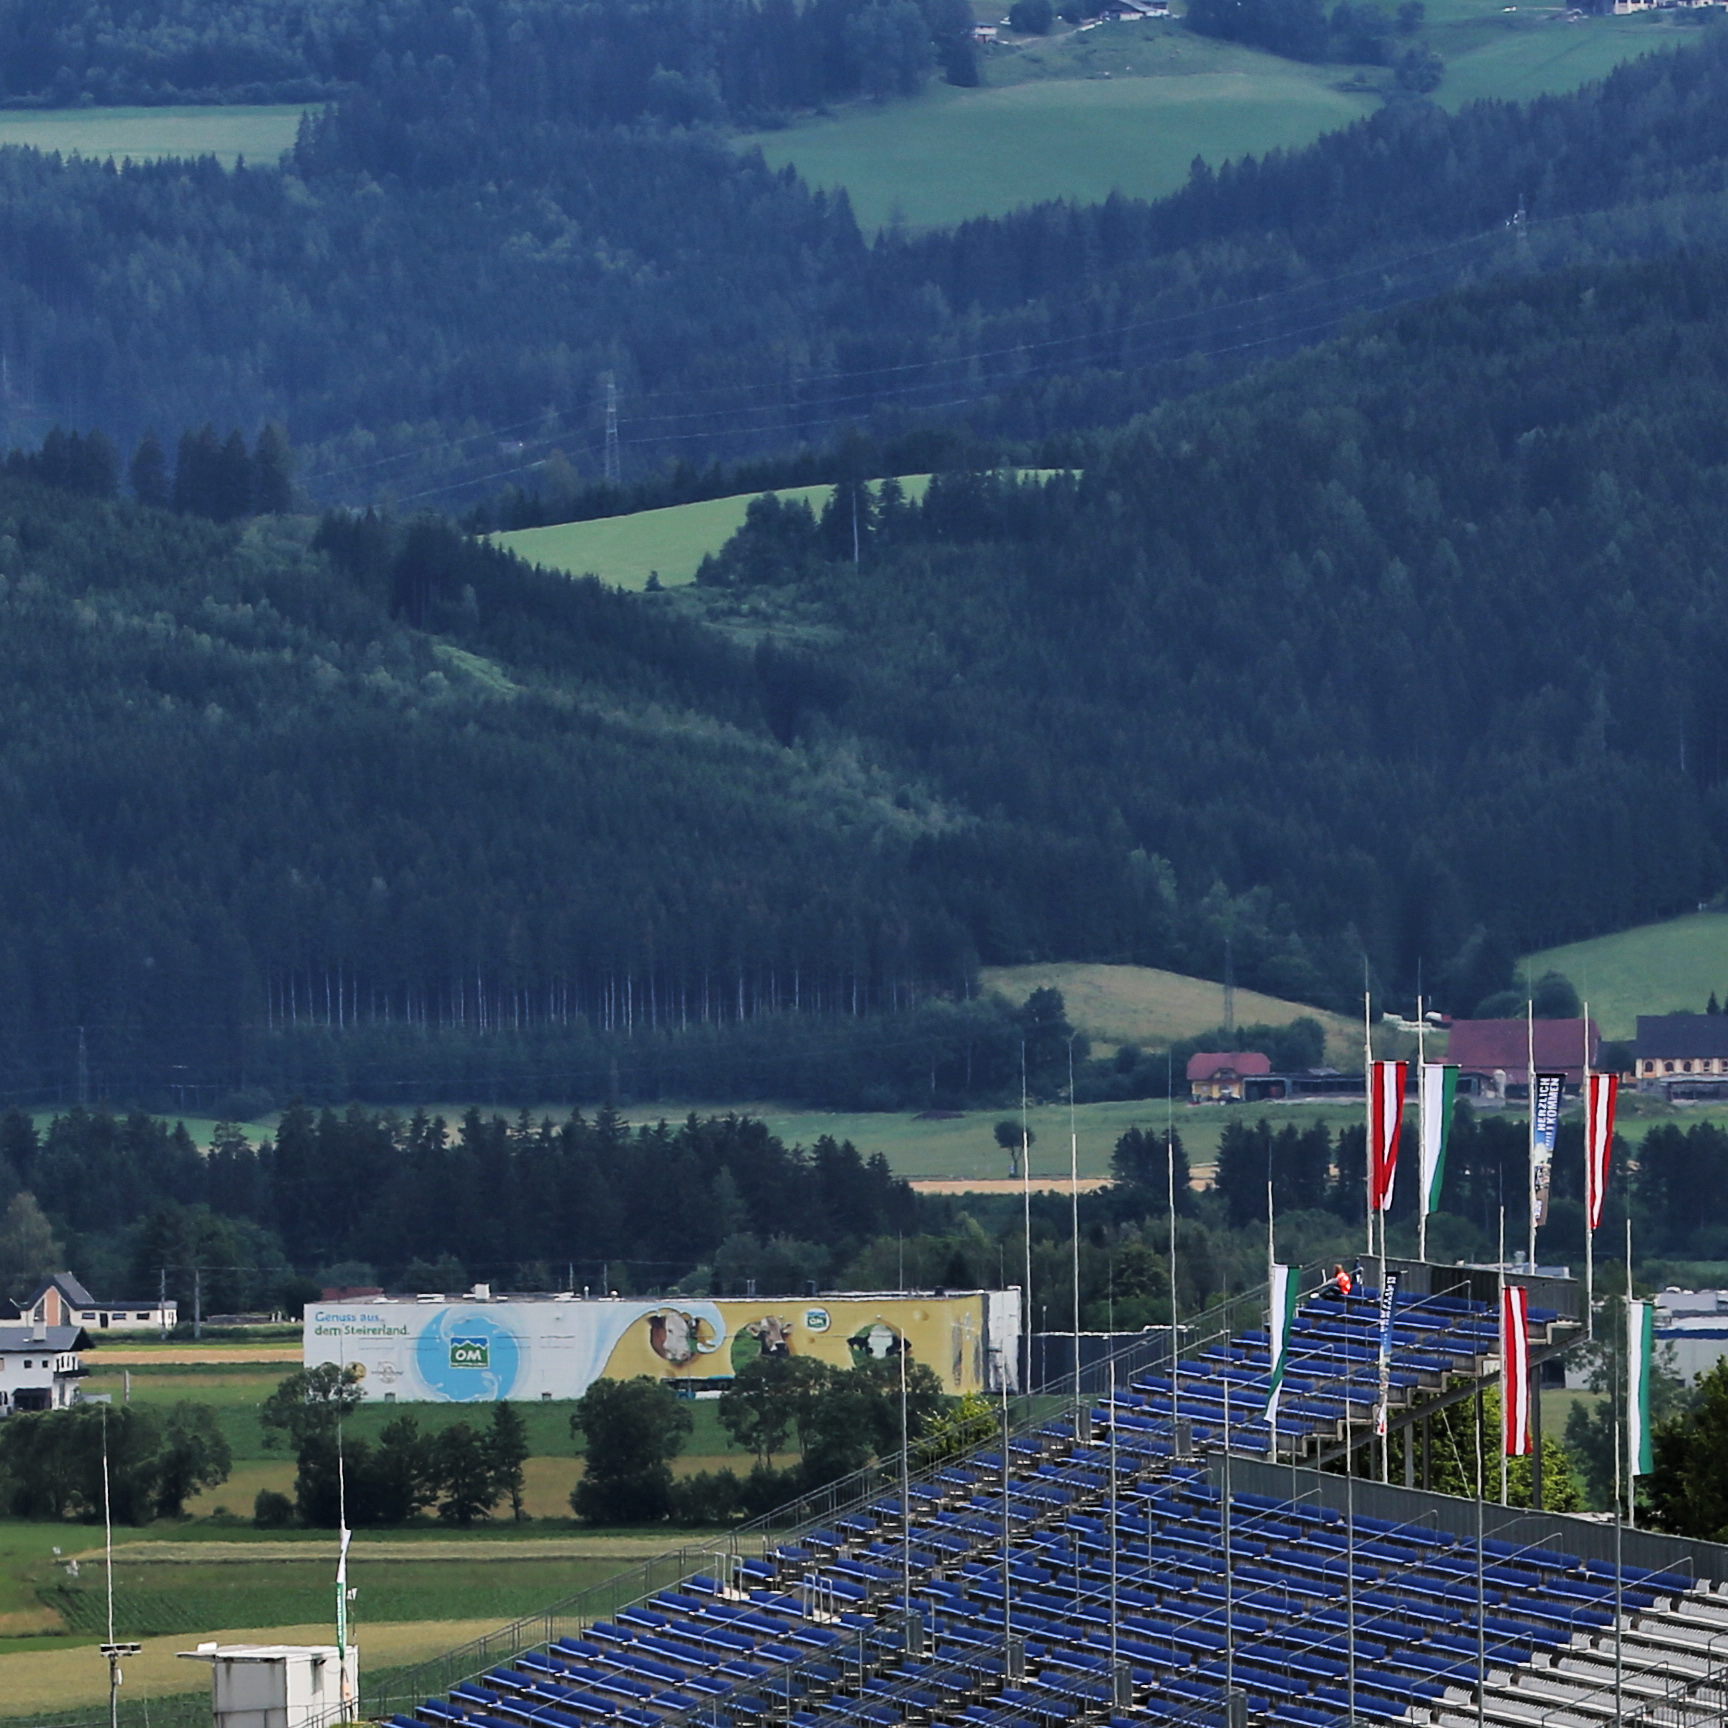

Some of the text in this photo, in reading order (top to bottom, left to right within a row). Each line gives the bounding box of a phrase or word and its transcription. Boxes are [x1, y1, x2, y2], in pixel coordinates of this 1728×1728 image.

[1537, 1077, 1551, 1131] HERZLICH
[315, 1311, 356, 1322] Genuss
[314, 1324, 410, 1336] dem Steirerland.
[455, 1349, 482, 1361] OM
